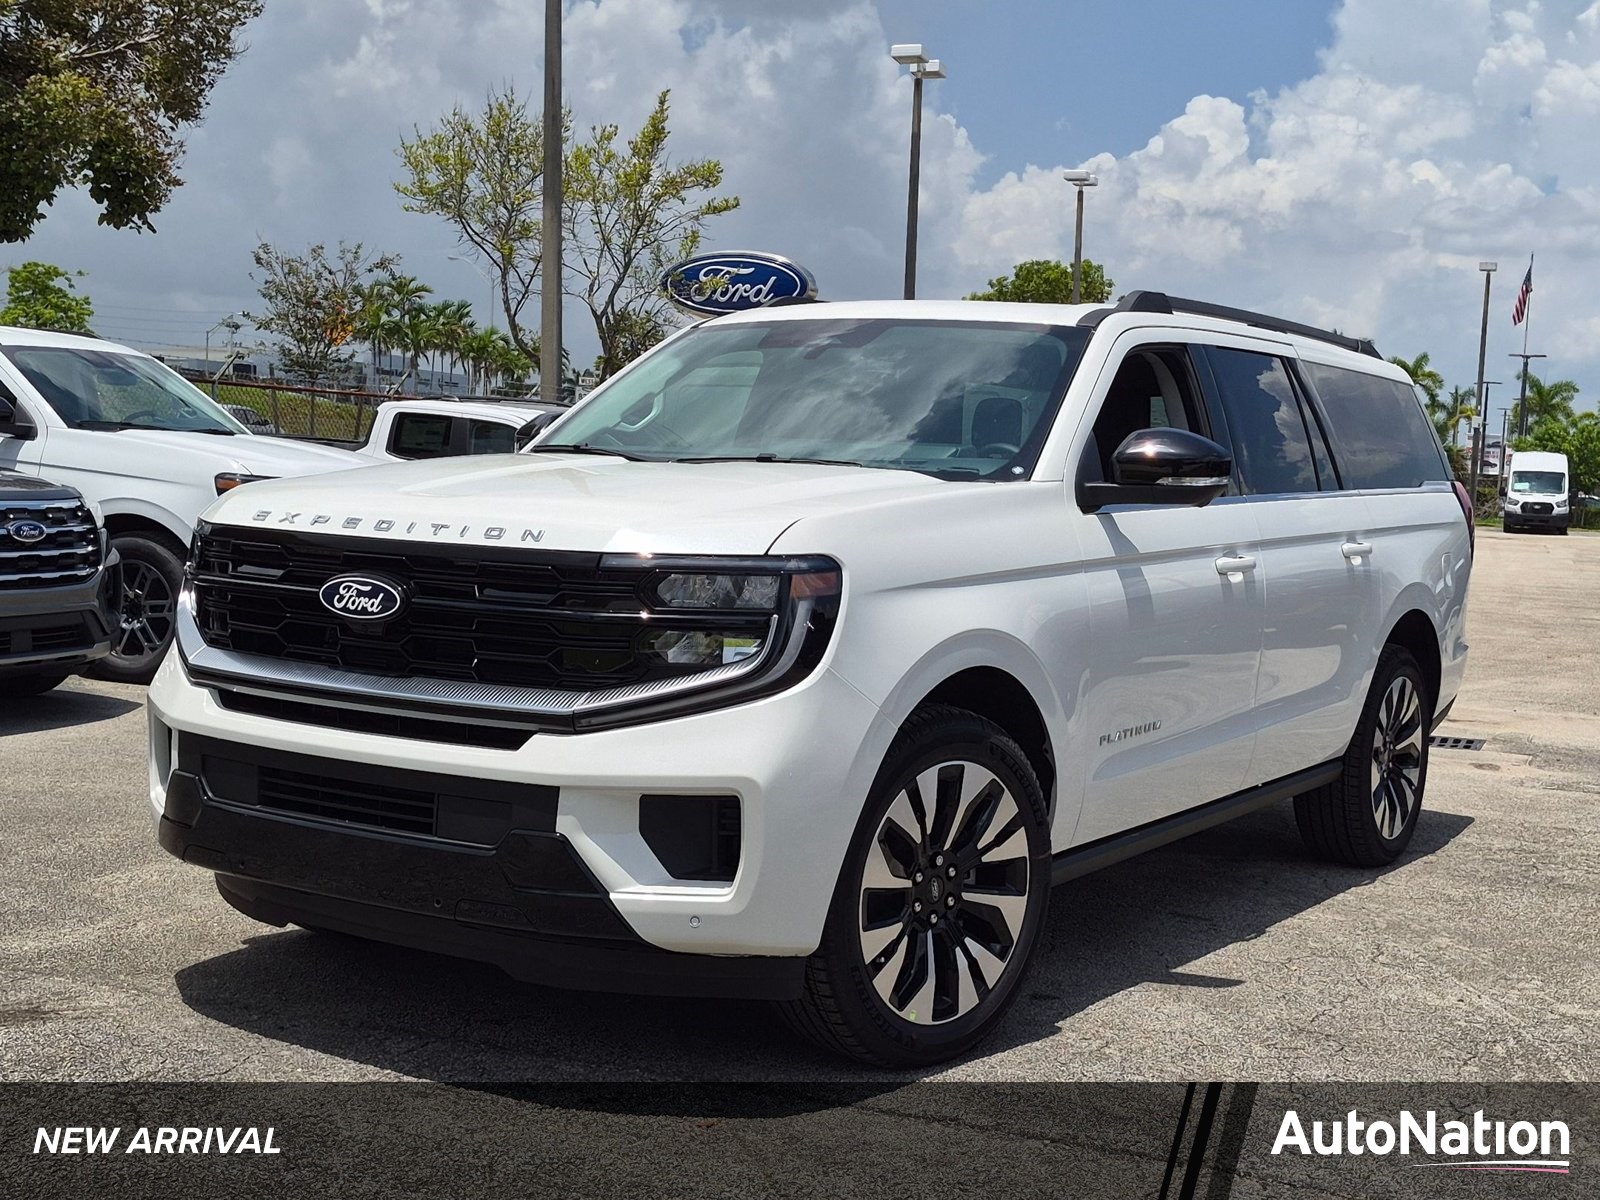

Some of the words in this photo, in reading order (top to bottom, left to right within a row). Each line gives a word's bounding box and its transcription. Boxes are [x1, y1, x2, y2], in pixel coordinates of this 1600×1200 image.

[690, 265, 777, 303] Ford
[252, 510, 546, 542] EXPEDITION
[333, 582, 384, 613] Ford
[1099, 720, 1162, 747] PLATINUM
